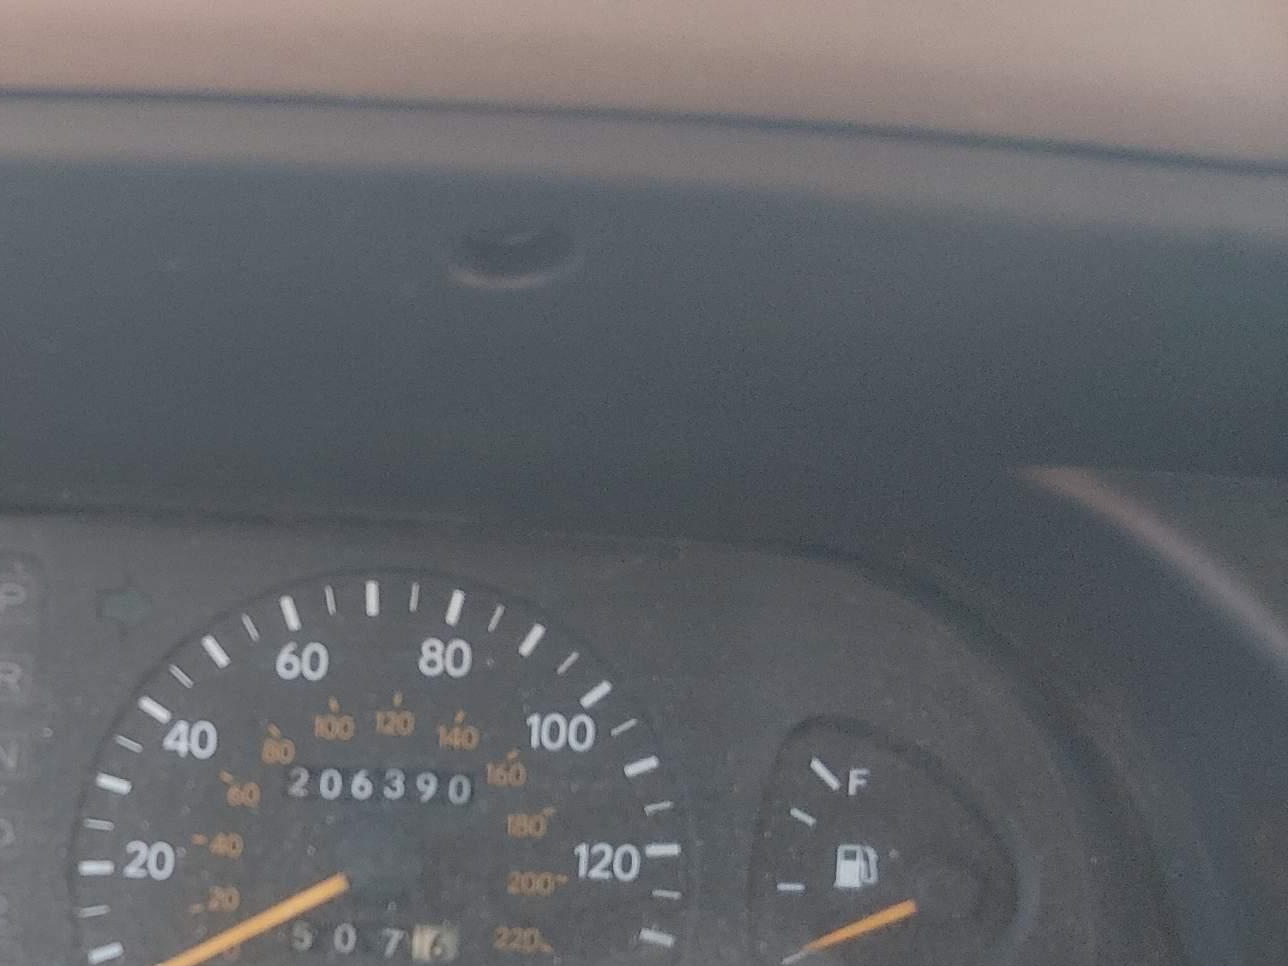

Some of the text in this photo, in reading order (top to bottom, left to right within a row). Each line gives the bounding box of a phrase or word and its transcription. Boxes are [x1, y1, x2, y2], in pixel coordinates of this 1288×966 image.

[275, 642, 329, 681] 60
[419, 639, 473, 678] 80
[163, 720, 218, 759] 40
[527, 713, 596, 752] 100
[848, 768, 870, 796] F
[123, 841, 175, 880] 20
[574, 843, 641, 882] 120
